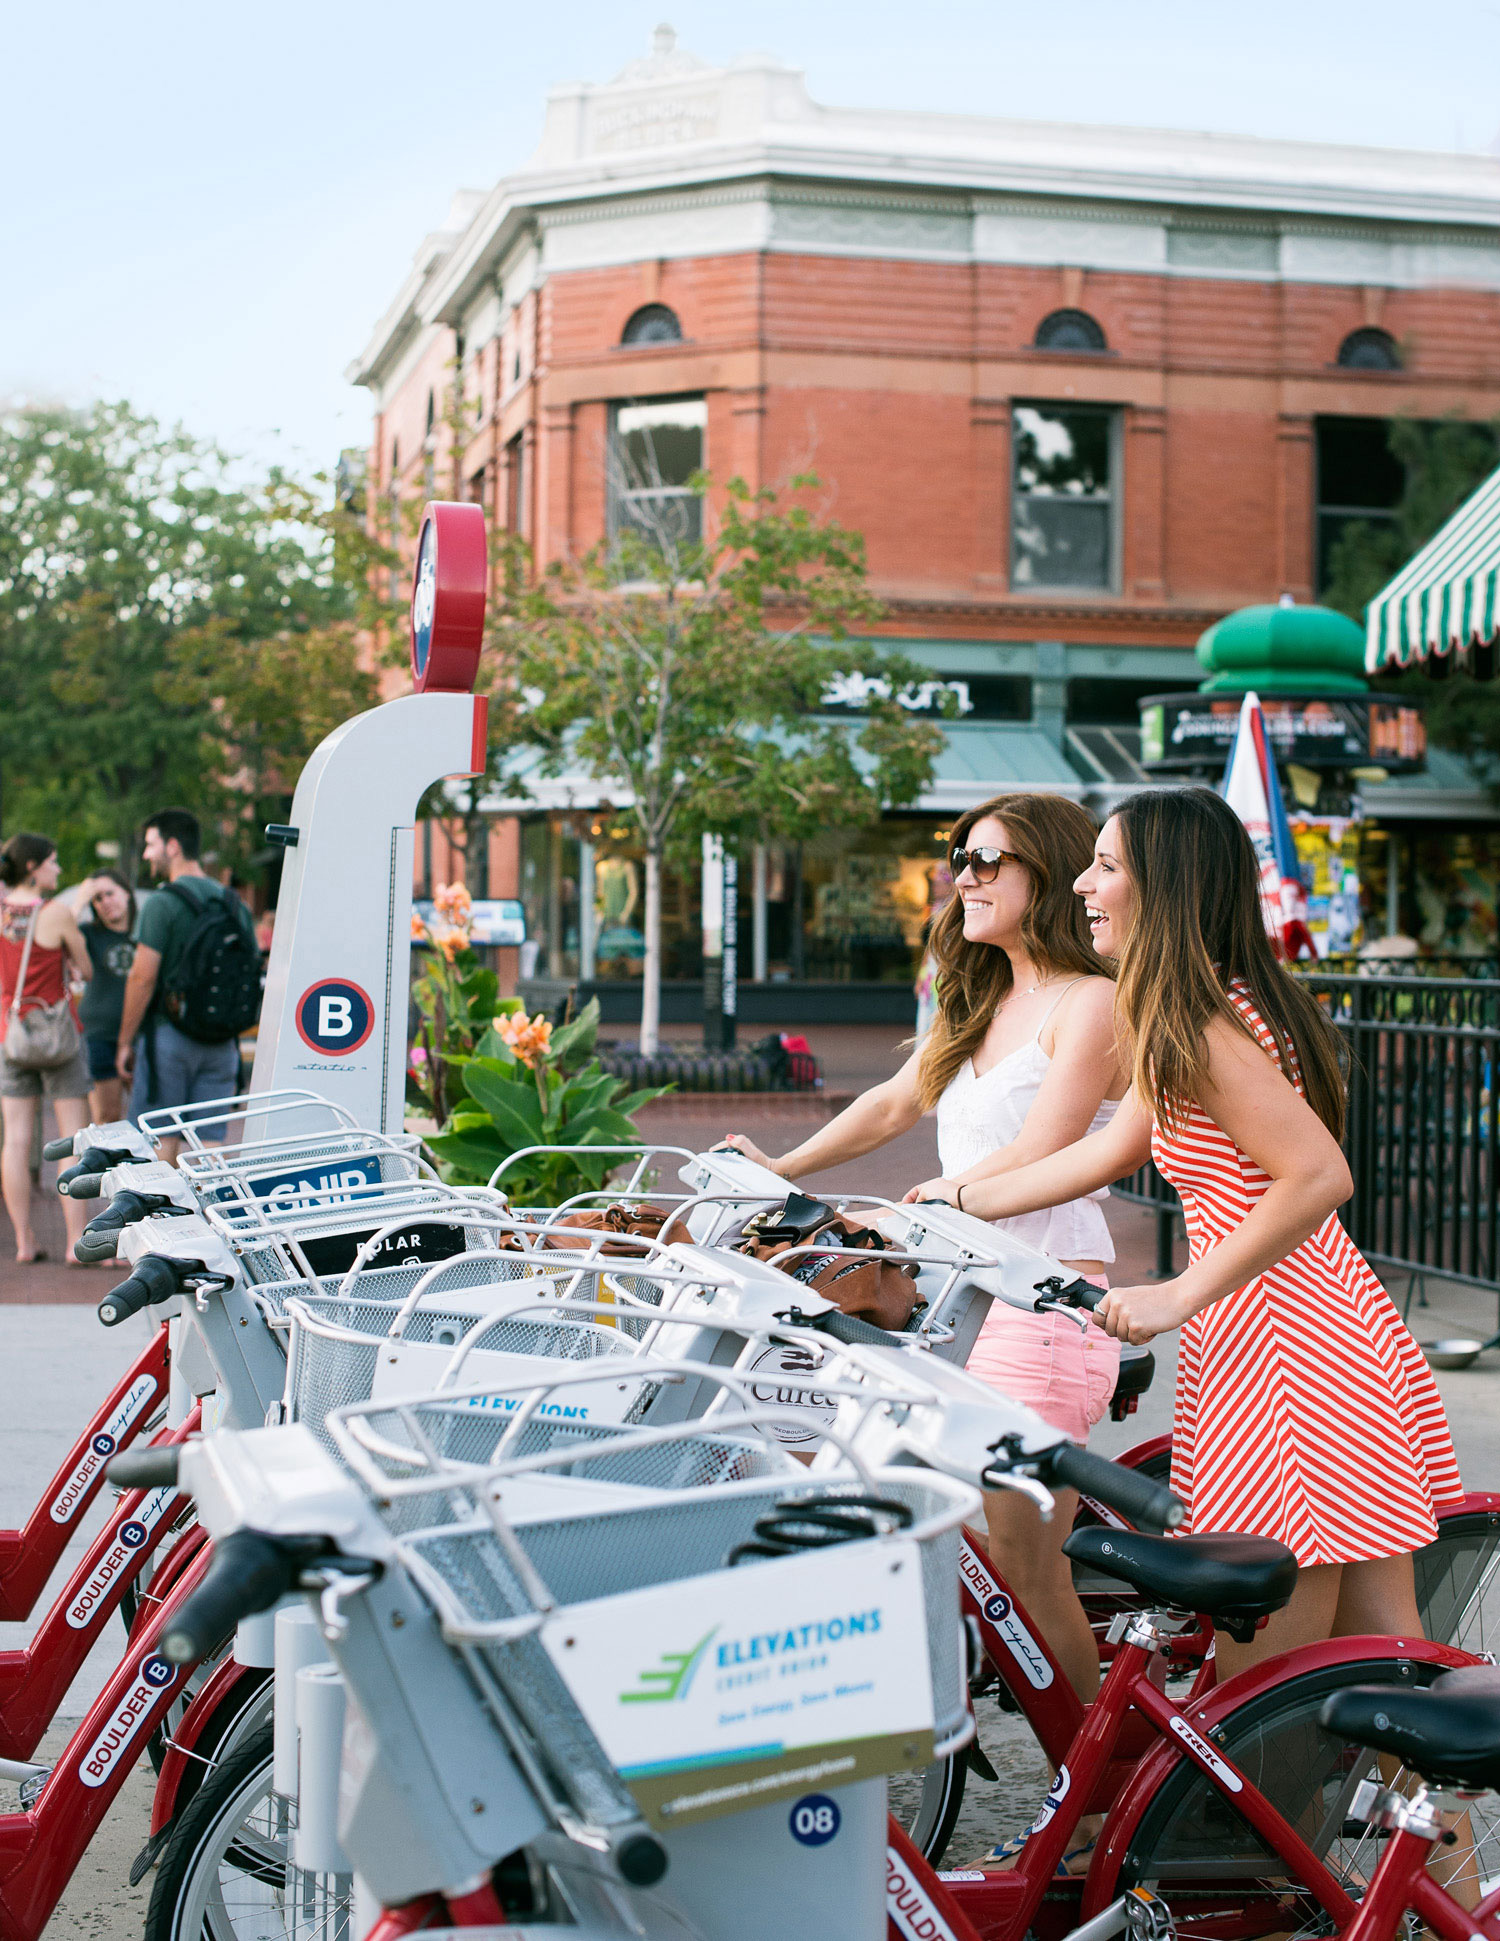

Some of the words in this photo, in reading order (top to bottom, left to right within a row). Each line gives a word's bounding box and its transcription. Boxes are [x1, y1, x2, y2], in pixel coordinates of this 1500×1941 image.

[318, 996, 352, 1037] B
[268, 1169, 368, 1213] GNIP
[55, 1455, 100, 1517] BOULDER
[71, 1546, 129, 1622] BOULDER
[716, 1608, 882, 1669] ELEVATIONS
[86, 1686, 153, 1778] BOULDER
[1177, 1721, 1220, 1766] TREK
[795, 1806, 834, 1835] 08
